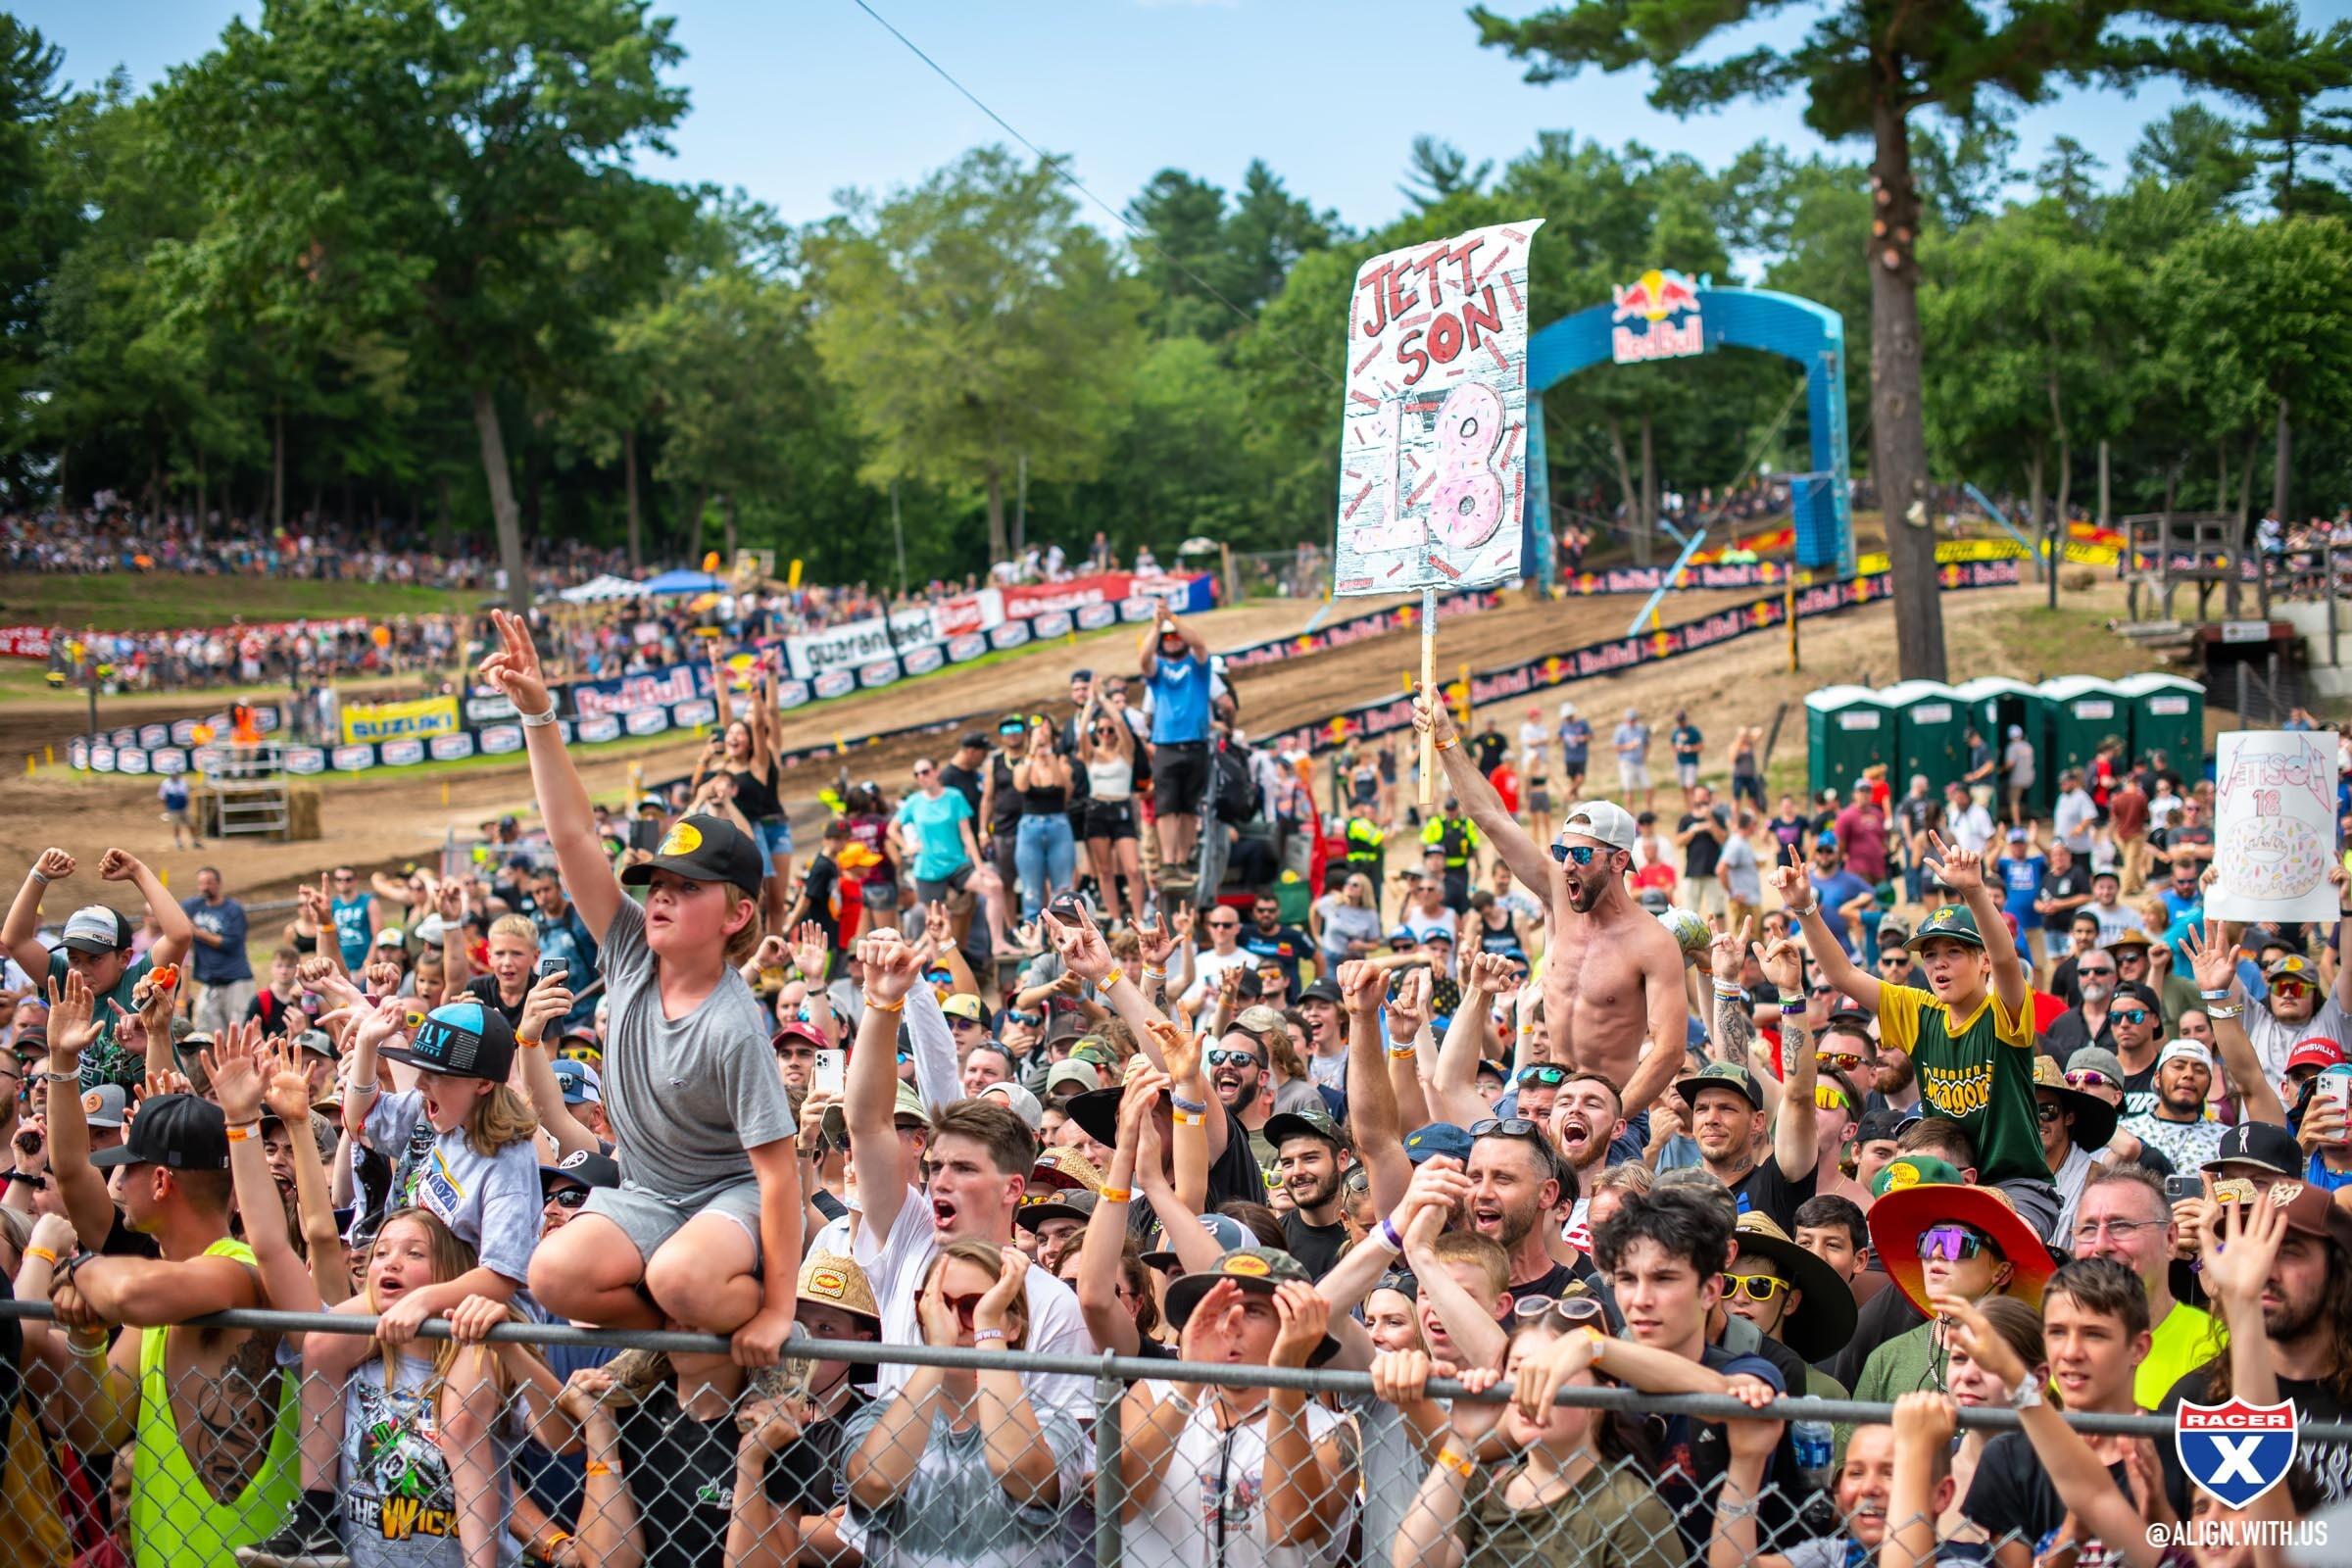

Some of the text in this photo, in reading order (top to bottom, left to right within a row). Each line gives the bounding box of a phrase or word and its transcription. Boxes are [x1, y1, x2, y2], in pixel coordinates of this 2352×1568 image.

[1359, 235, 1486, 337] JETT
[1397, 284, 1503, 385] SON
[1353, 381, 1505, 555] 18
[808, 608, 933, 667] guaraneed
[575, 678, 636, 719] Red
[637, 665, 696, 708] Bull
[352, 712, 452, 739] SUZUKI
[2252, 789, 2281, 817] 18
[416, 1021, 452, 1048] FLY
[2293, 1043, 2336, 1058] LOUISVILLE
[423, 1188, 447, 1217] SOUTHWICK
[431, 1176, 457, 1208] 2021
[347, 1494, 380, 1529] THE
